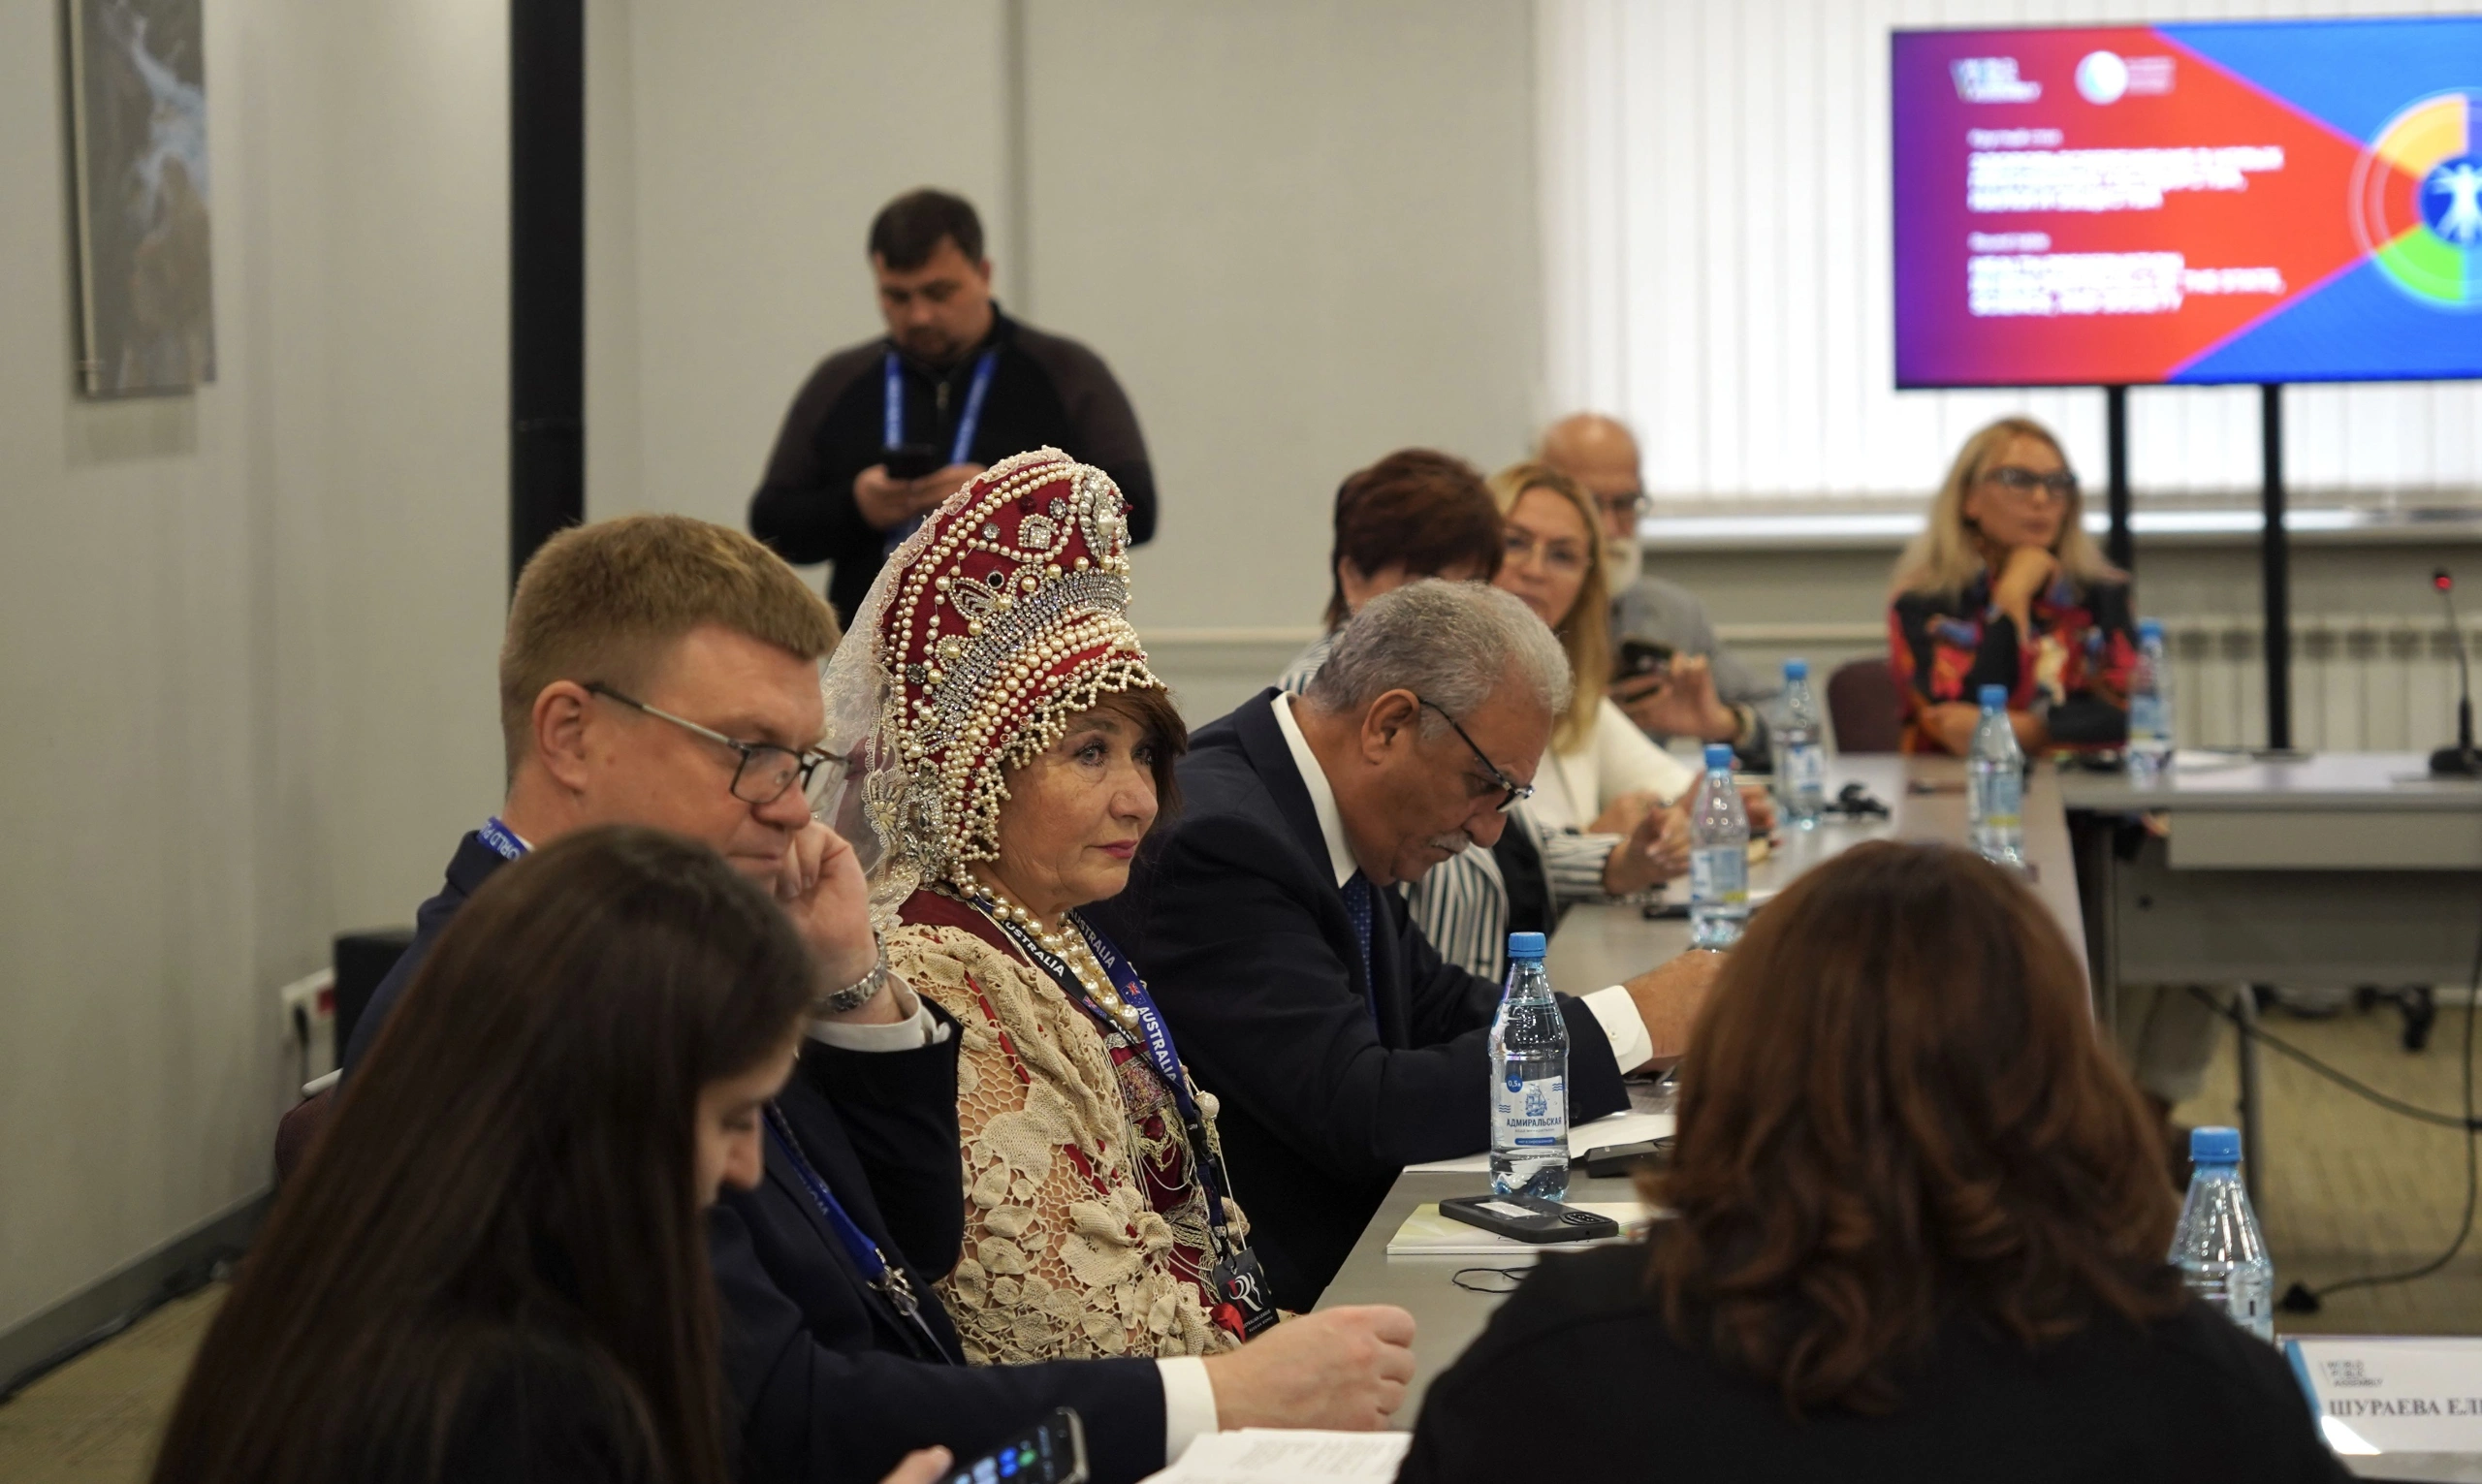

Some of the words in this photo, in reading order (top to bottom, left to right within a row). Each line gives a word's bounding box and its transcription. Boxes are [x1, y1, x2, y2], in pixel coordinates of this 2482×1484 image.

[1001, 920, 1066, 978] USTRALIA
[1067, 908, 1117, 969] AUSTRALIA
[1136, 1005, 1177, 1083] AUSTRALIA
[1507, 1117, 1562, 1127] АДМИРАЛЬСКАЯ
[2329, 1398, 2441, 1416] ШУРАЕВА
